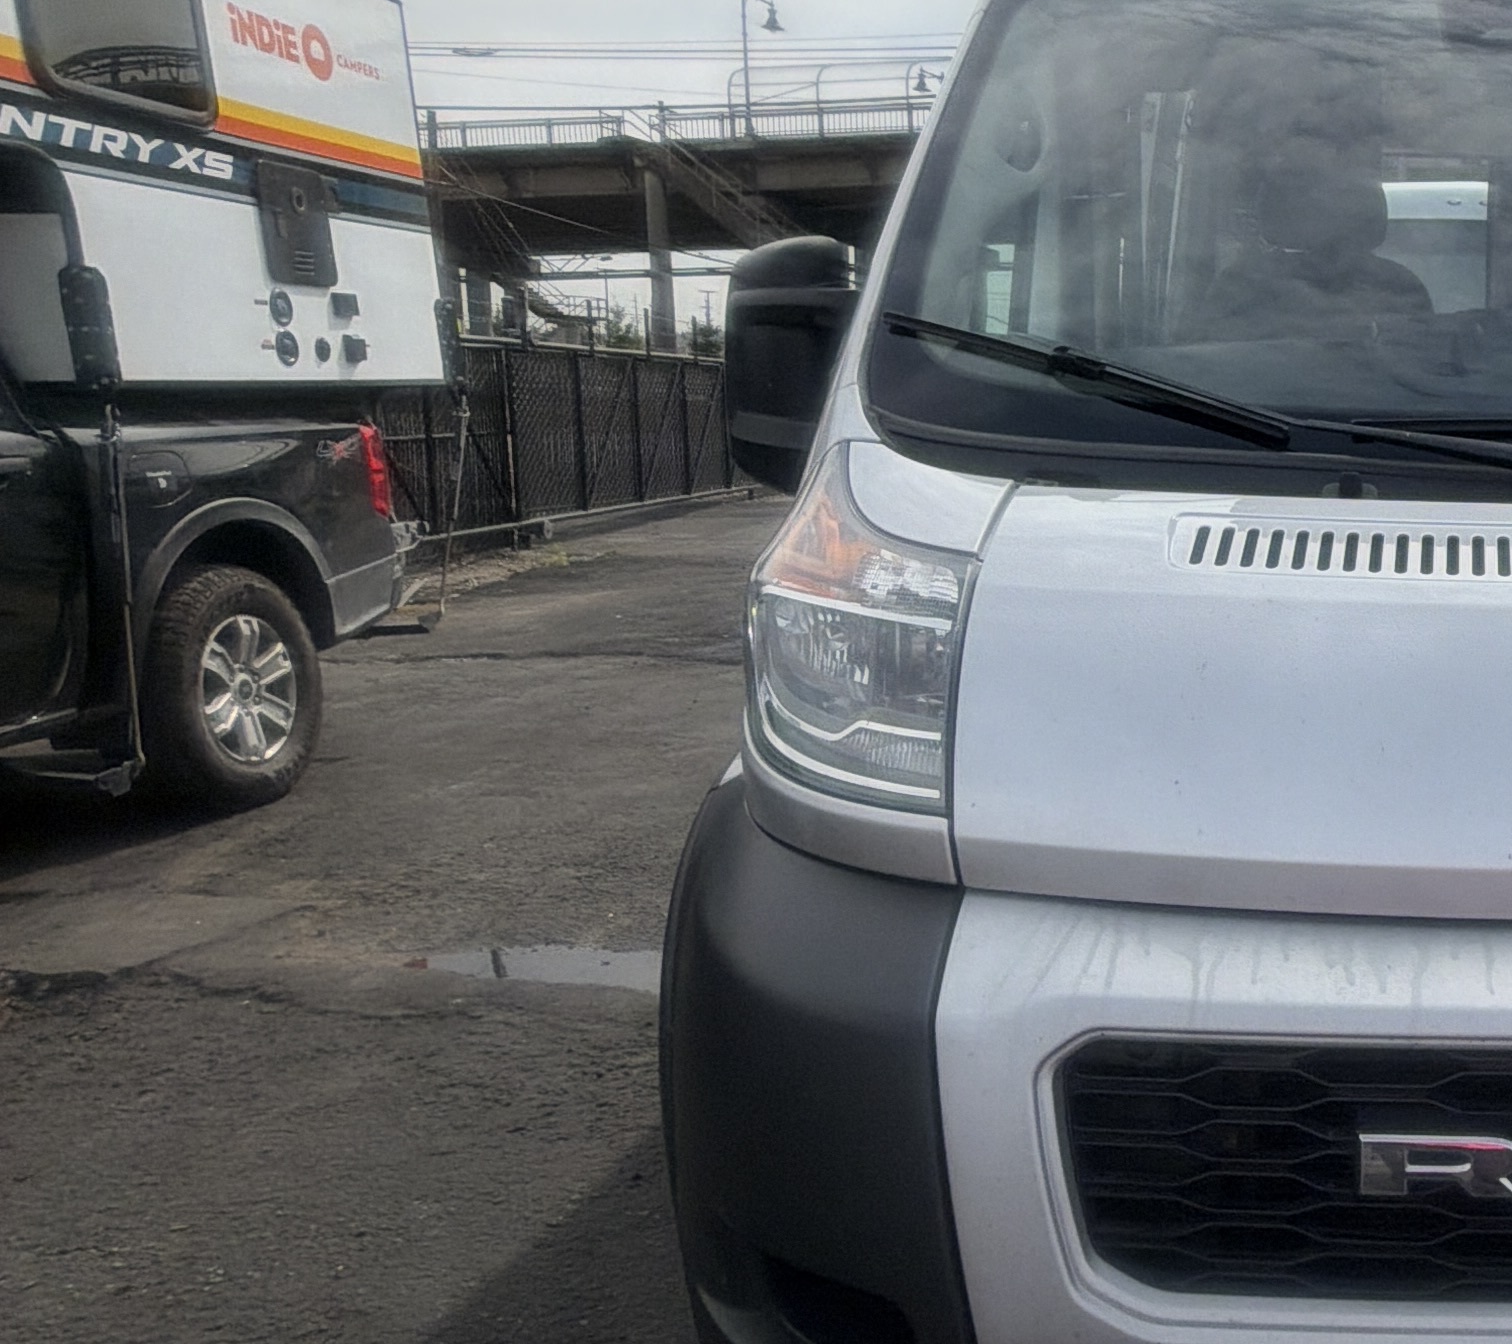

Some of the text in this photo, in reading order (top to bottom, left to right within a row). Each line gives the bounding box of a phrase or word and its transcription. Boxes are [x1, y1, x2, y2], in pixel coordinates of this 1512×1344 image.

[336, 54, 380, 80] CAMPERS
[0, 103, 234, 180] NTRY XS
